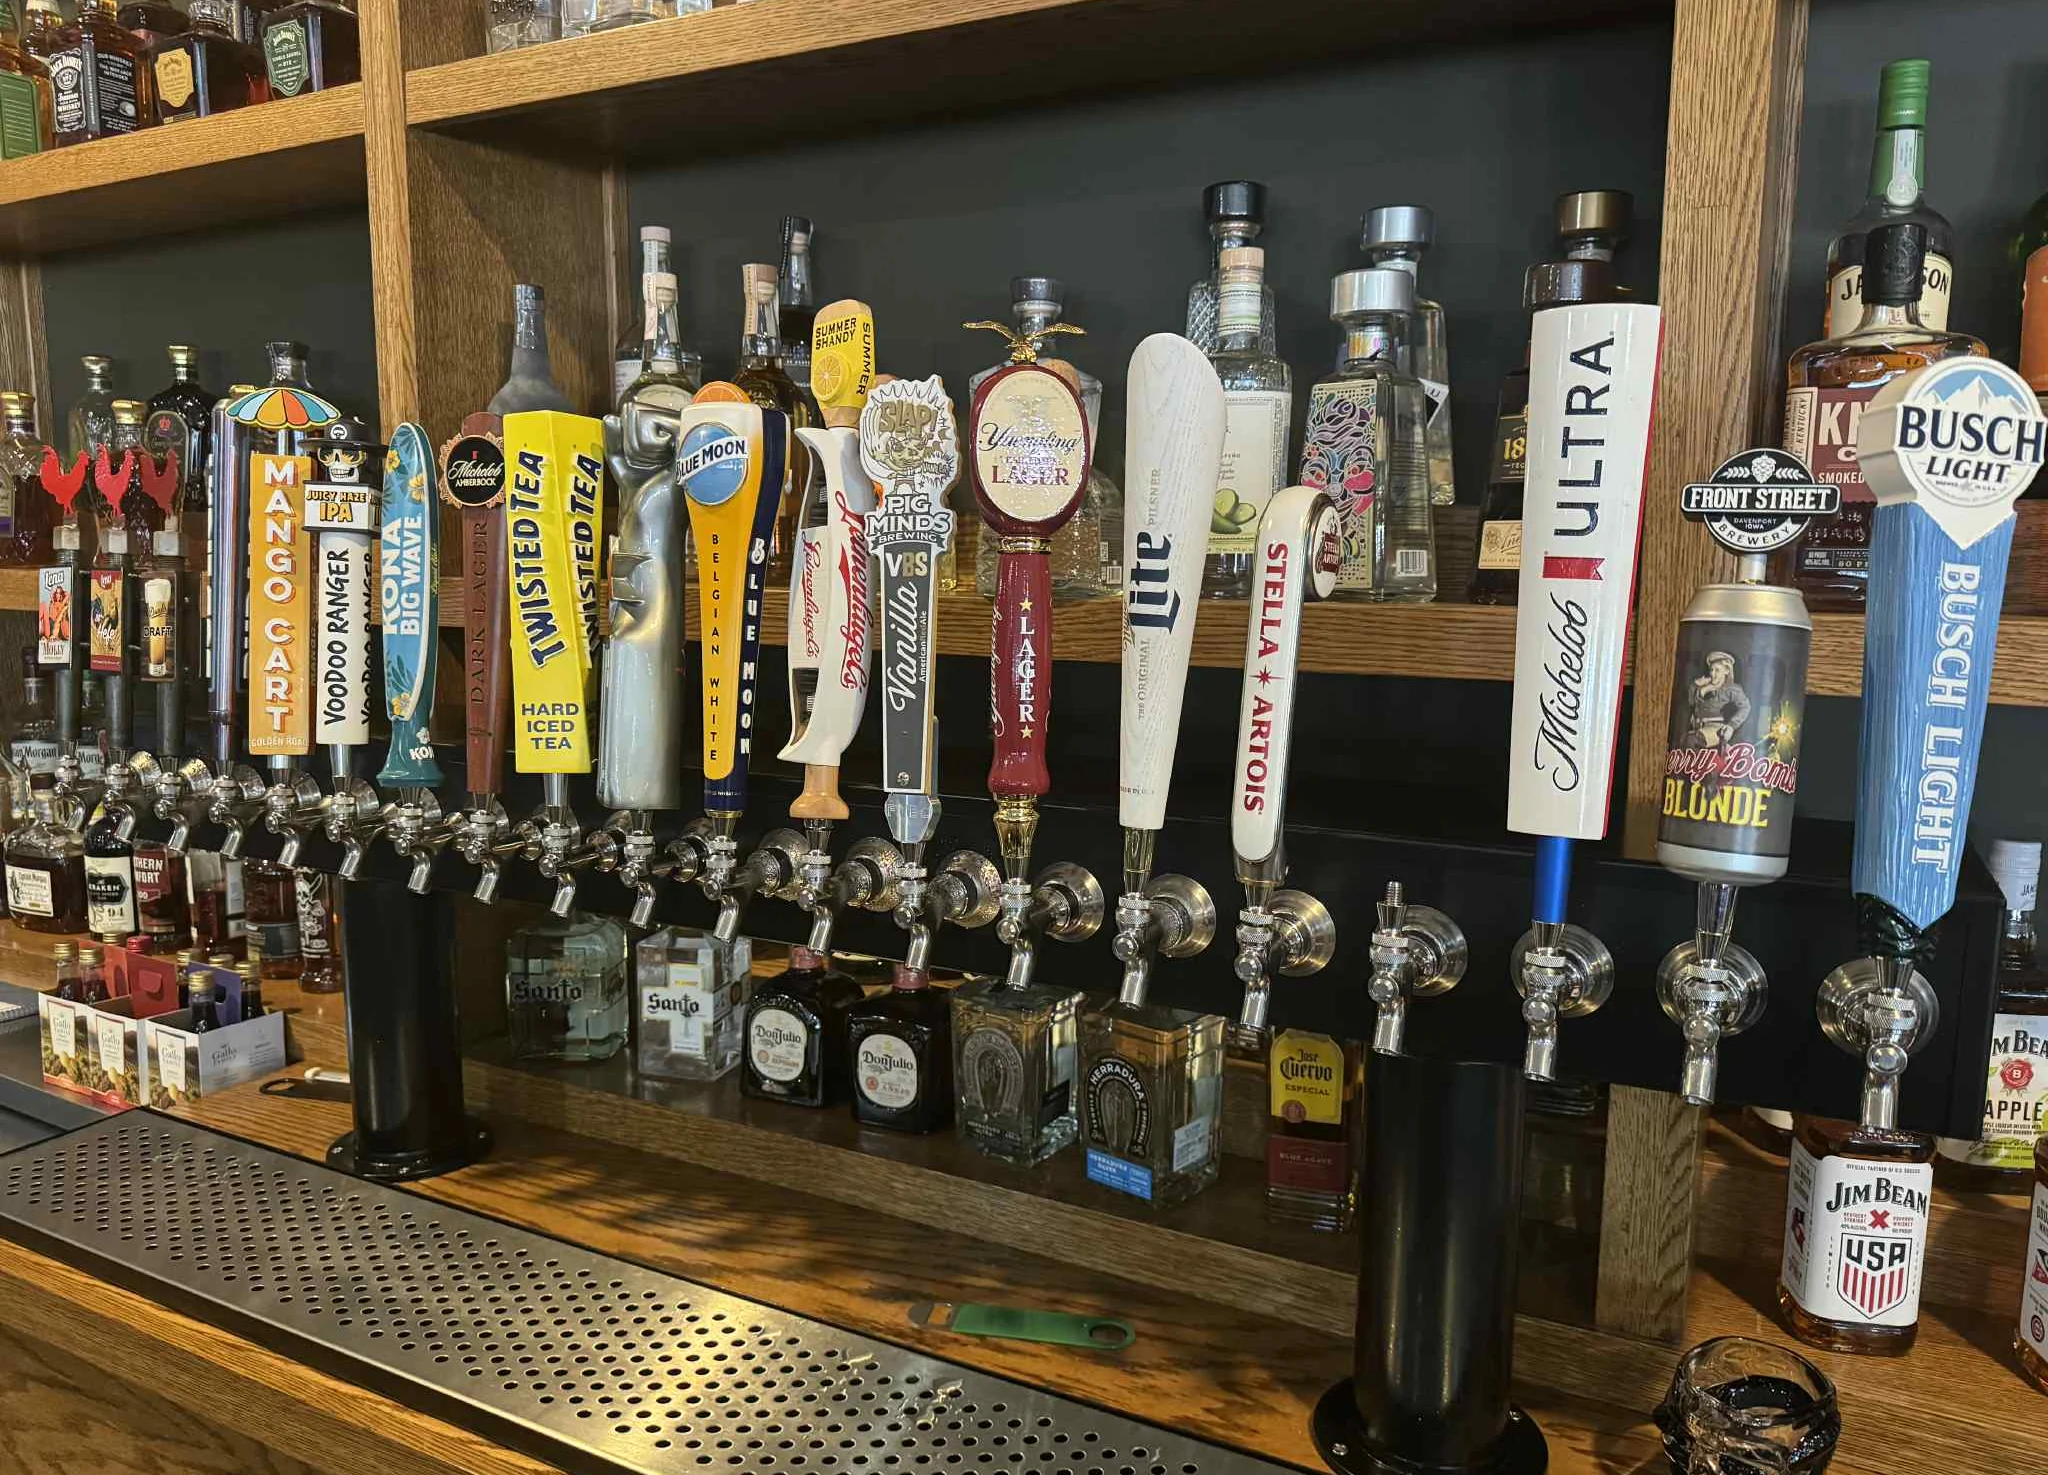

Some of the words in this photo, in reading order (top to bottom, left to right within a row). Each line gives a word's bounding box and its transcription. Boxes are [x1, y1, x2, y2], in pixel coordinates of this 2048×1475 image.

[815, 317, 857, 338] SUMMER
[815, 329, 856, 350] SHANDY
[856, 322, 871, 395] SUMMER
[1553, 331, 1615, 538] ULTRA
[1818, 401, 1869, 446] KN
[1898, 405, 2044, 464] BUSCH
[447, 459, 502, 479] Michelob
[455, 476, 497, 488] AMBERBOCK
[509, 449, 545, 513] TEA
[676, 454, 700, 484] BLUE
[702, 440, 745, 465] MOON
[1818, 471, 1865, 484] SMOKED
[1926, 456, 2011, 483] LIGHT
[306, 490, 338, 502] JUICY
[340, 491, 368, 503] HAZE
[567, 452, 602, 517] TEA
[884, 493, 931, 514] PIG
[1148, 468, 1162, 525] PILSNER
[1690, 487, 1752, 509] FRONT
[1755, 488, 1832, 510] STREET
[263, 459, 299, 604] MANGO
[320, 502, 353, 522] IPA
[866, 510, 951, 537] MINDS
[1733, 517, 1777, 525] DAVENPORT
[401, 514, 422, 583] WAVE
[879, 532, 937, 544] BREWING
[1718, 523, 1790, 546] BREWERY
[44, 570, 64, 588] Lena
[382, 519, 402, 636] KONA
[470, 521, 489, 614] LAGER
[885, 551, 928, 577] VBS
[1129, 531, 1181, 635] Lite
[326, 547, 350, 639] RANGER
[400, 585, 420, 636] BIG
[513, 518, 568, 669] TWISTED
[710, 534, 720, 656] BELGIAN
[745, 537, 766, 642] BLUE
[834, 490, 874, 694] Leinenkugel's
[1257, 541, 1289, 659] STELLA
[98, 625, 115, 643] Hefe
[144, 626, 173, 638] DRAFT
[887, 580, 918, 712] Vanilla
[1926, 559, 1980, 710] BUSCH
[263, 618, 296, 734] CART
[324, 640, 347, 726] VOODOO
[470, 627, 486, 704] DARK
[919, 642, 927, 682] American
[1017, 616, 1036, 722] LAGER
[1139, 637, 1150, 701] ORIGINAL
[521, 702, 580, 717] HARD
[740, 661, 757, 755] MOON
[1534, 590, 1589, 793] Michelob
[526, 719, 575, 733] ICED
[709, 677, 720, 762] WHITE
[531, 736, 573, 750] TEA
[1243, 695, 1274, 813] ARTOIS
[1663, 778, 1773, 828] BLONDE
[1912, 723, 1963, 874] LIGHT
[514, 979, 583, 1001] Santo
[647, 993, 699, 1018] Santo
[2013, 1029, 2048, 1060] BEA
[1090, 1063, 1145, 1100] HERRADURA
[1280, 1057, 1333, 1082] Cuervo
[1285, 1083, 1331, 1096] ESPECIAL
[1983, 1100, 2043, 1121] APPLE
[1826, 1181, 1872, 1212] JIM
[1846, 1239, 1906, 1272] USA
